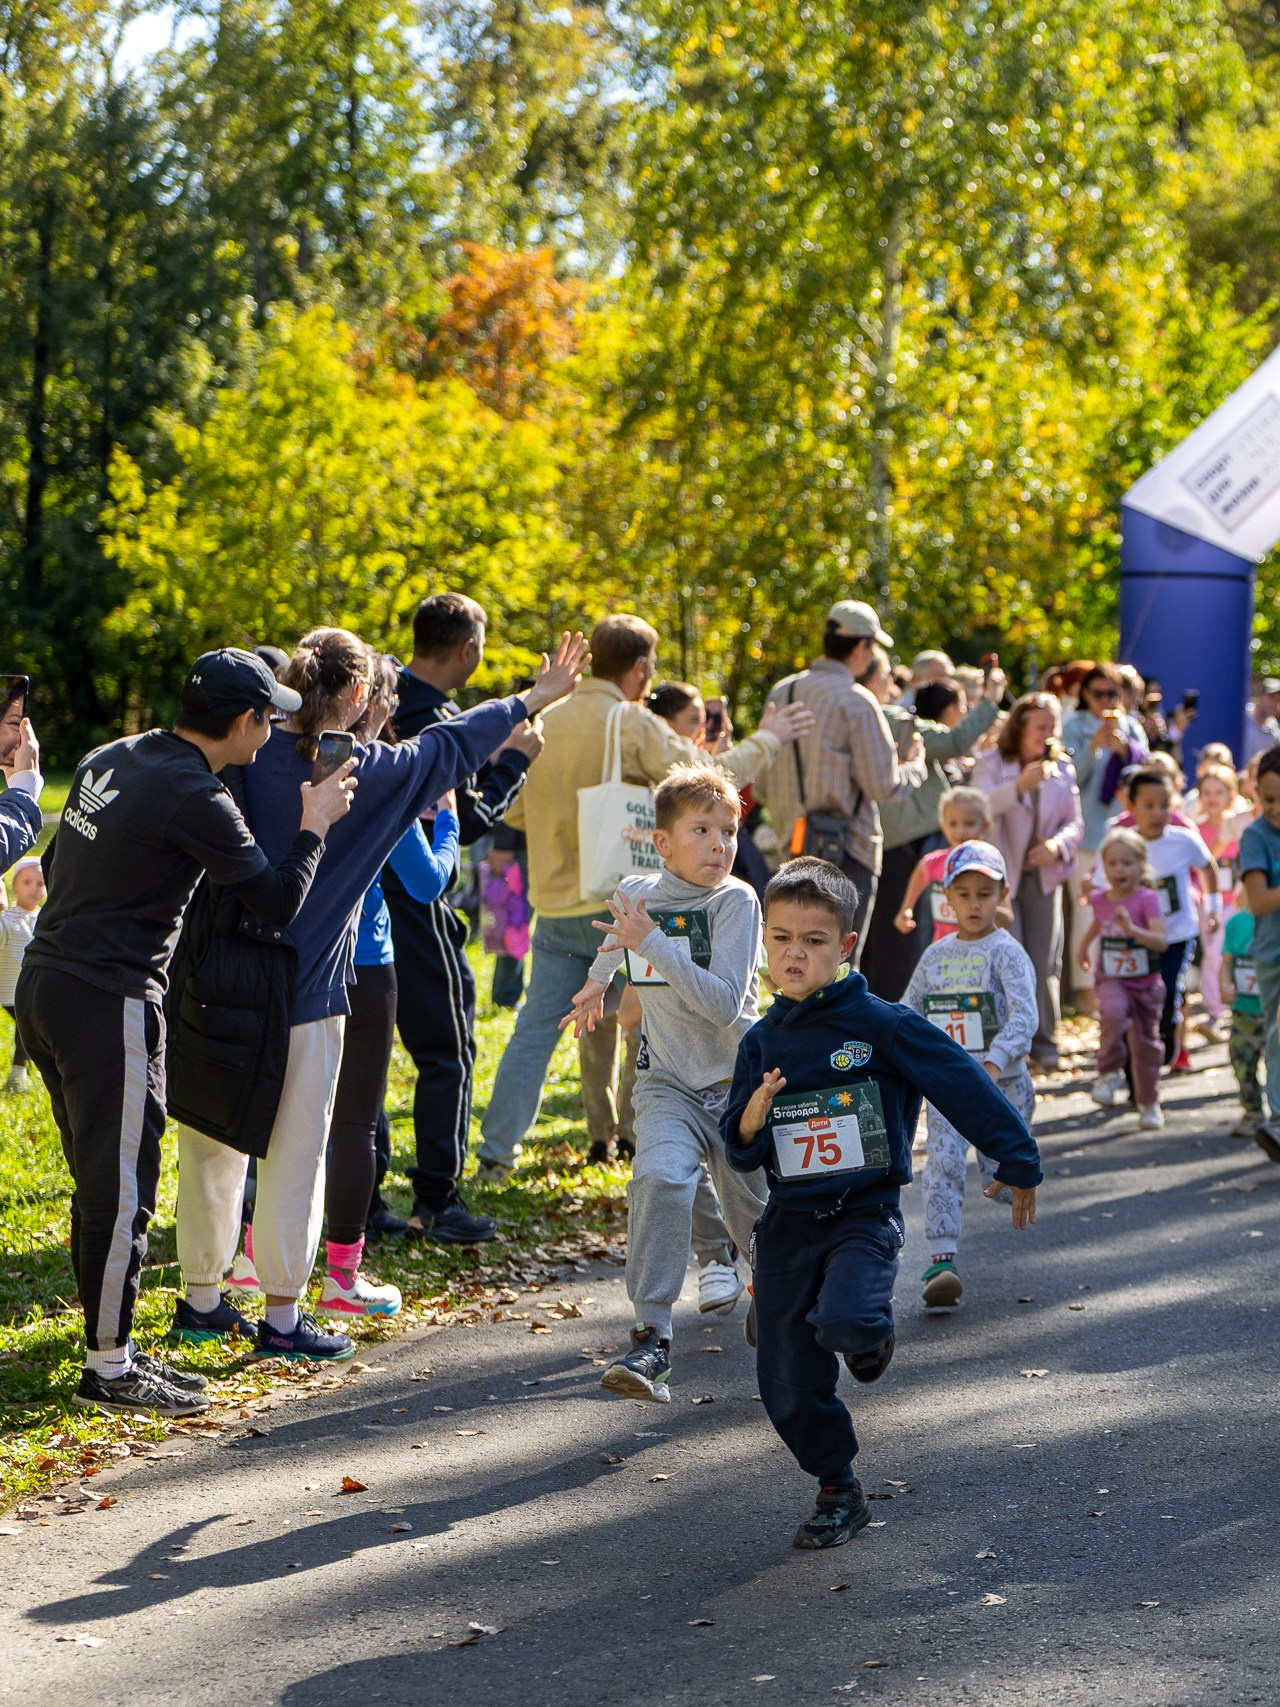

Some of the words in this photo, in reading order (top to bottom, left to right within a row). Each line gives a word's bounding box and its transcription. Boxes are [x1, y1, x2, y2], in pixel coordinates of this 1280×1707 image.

[65, 807, 98, 840] adidas
[1112, 957, 1137, 974] 73
[945, 1023, 966, 1046] 11
[773, 1107, 782, 1119] 5
[781, 1107, 820, 1119] городов
[811, 1119, 829, 1129] Дети
[793, 1132, 843, 1169] 75
